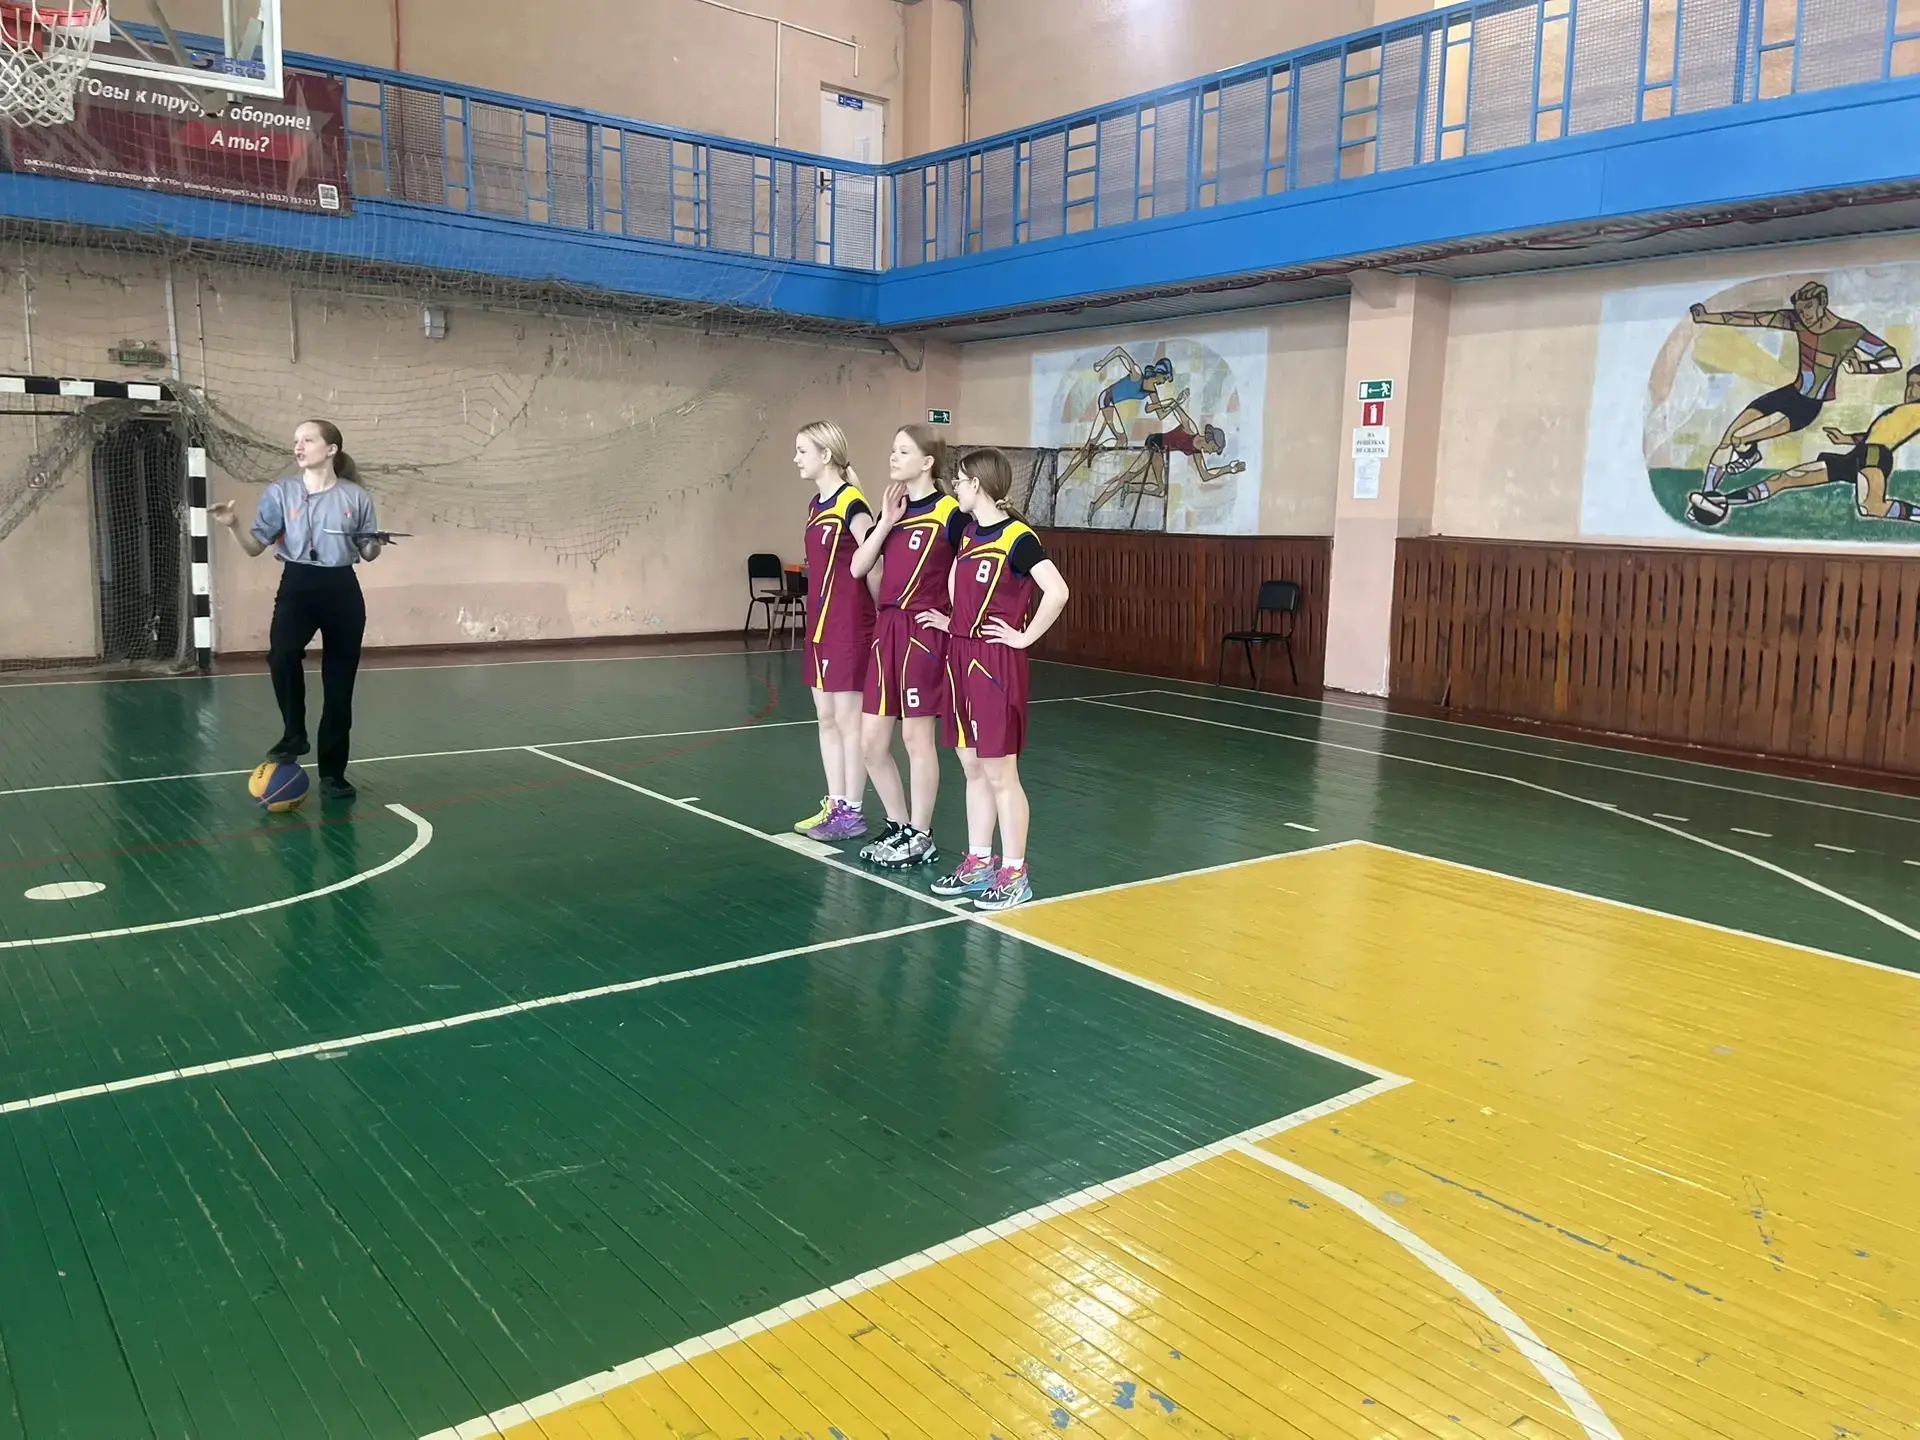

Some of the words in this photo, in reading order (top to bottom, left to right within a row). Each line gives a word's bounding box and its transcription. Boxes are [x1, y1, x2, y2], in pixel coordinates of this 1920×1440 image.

[76, 76, 129, 100] ТОвы
[136, 90, 146, 103] к
[230, 106, 311, 131] обороне!
[210, 130, 224, 147] А
[228, 136, 270, 153] ты?
[821, 526, 832, 545] 7
[908, 530, 924, 550] 6
[976, 560, 991, 584] 8
[821, 659, 829, 678] 7
[906, 688, 920, 708] 6
